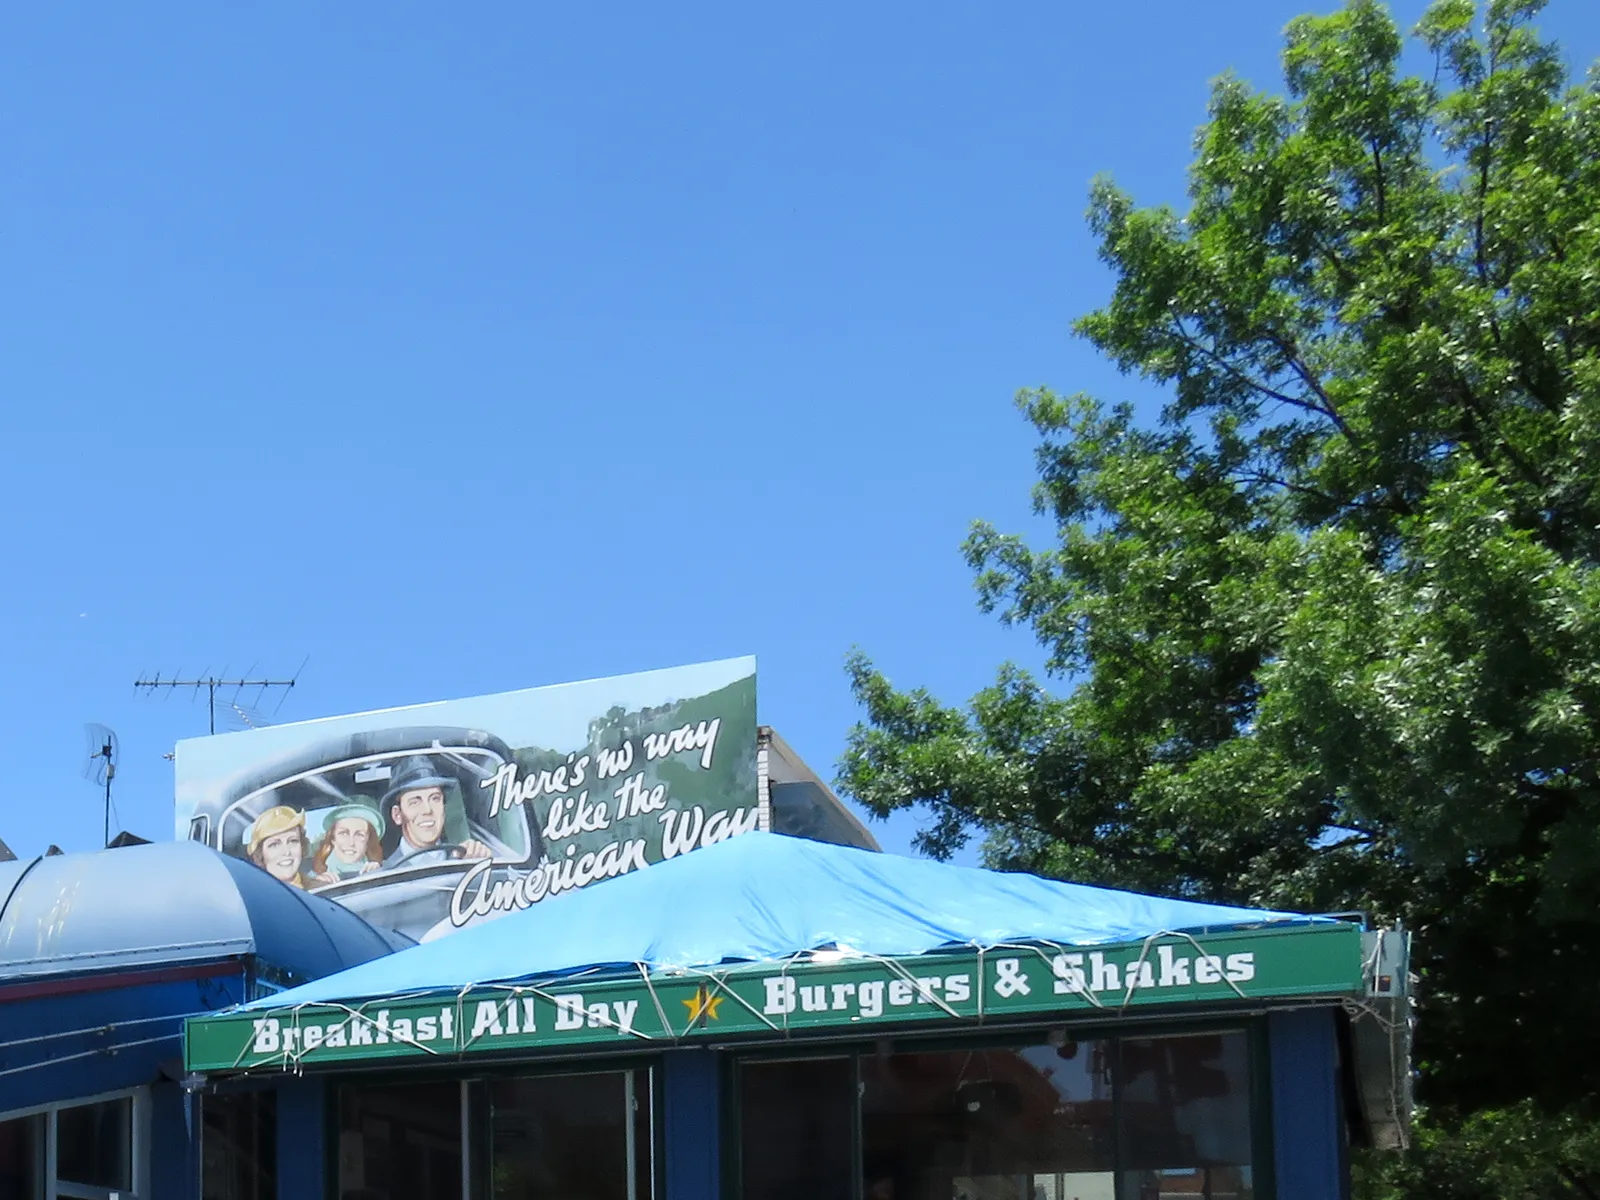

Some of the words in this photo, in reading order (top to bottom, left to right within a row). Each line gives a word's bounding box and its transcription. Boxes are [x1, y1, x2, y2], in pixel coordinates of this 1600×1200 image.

[481, 748, 588, 818] There's
[595, 738, 636, 778] no
[642, 717, 721, 772] way
[542, 792, 611, 841] like
[450, 834, 649, 927] American
[763, 973, 971, 1018] Burgers
[994, 958, 1032, 998] &
[1053, 946, 1256, 995] Shakes
[252, 1008, 455, 1054] Breakfast
[472, 998, 538, 1038] All
[554, 992, 639, 1035] Day
